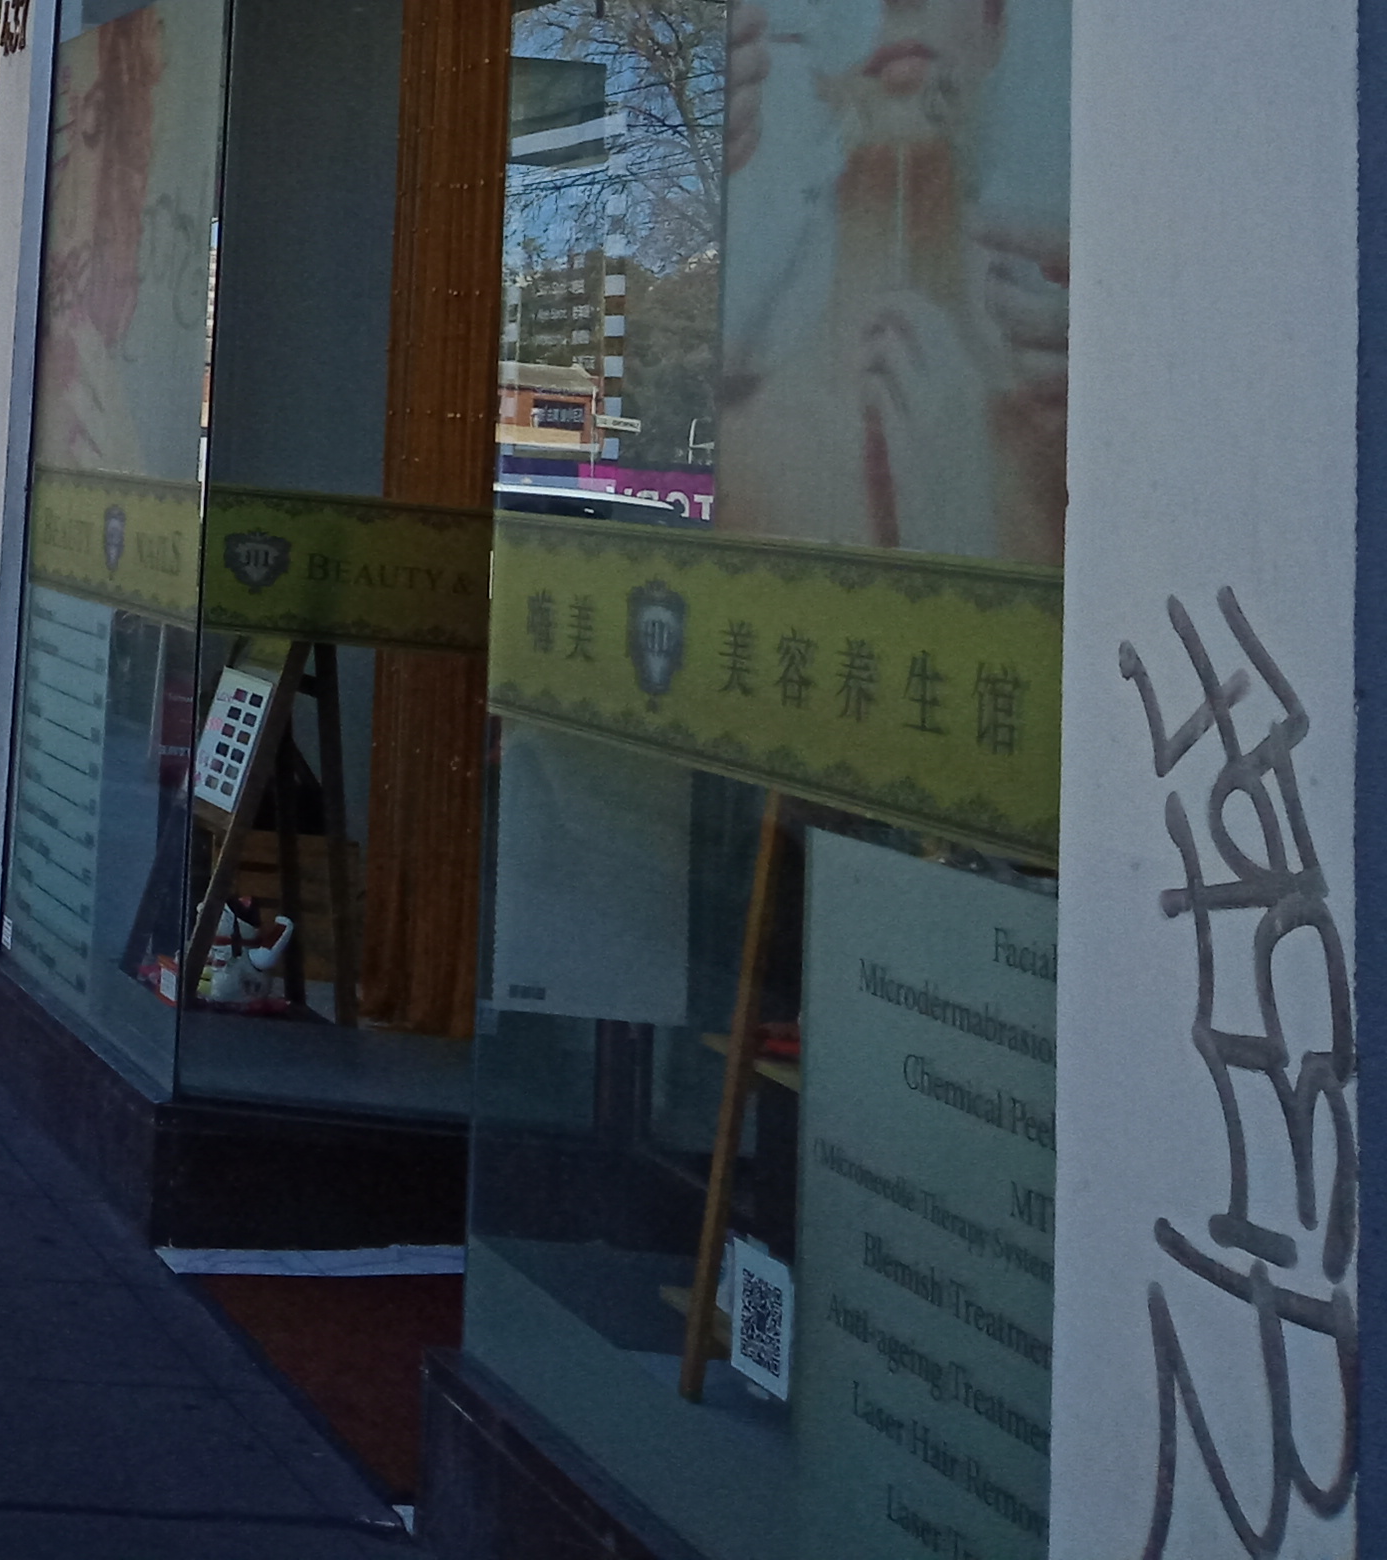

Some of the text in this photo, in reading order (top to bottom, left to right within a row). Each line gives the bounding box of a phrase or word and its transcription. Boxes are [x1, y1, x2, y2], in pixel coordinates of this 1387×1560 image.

[307, 553, 444, 591] BEAUTY
[452, 573, 472, 596] &
[719, 620, 1033, 756] 美容养生馆
[859, 959, 1056, 1065] Microdermabrasio
[903, 1054, 1002, 1127] Chemical
[863, 1232, 944, 1308] Blemish
[853, 1380, 904, 1446] Laser
[912, 1420, 957, 1481] Hair
